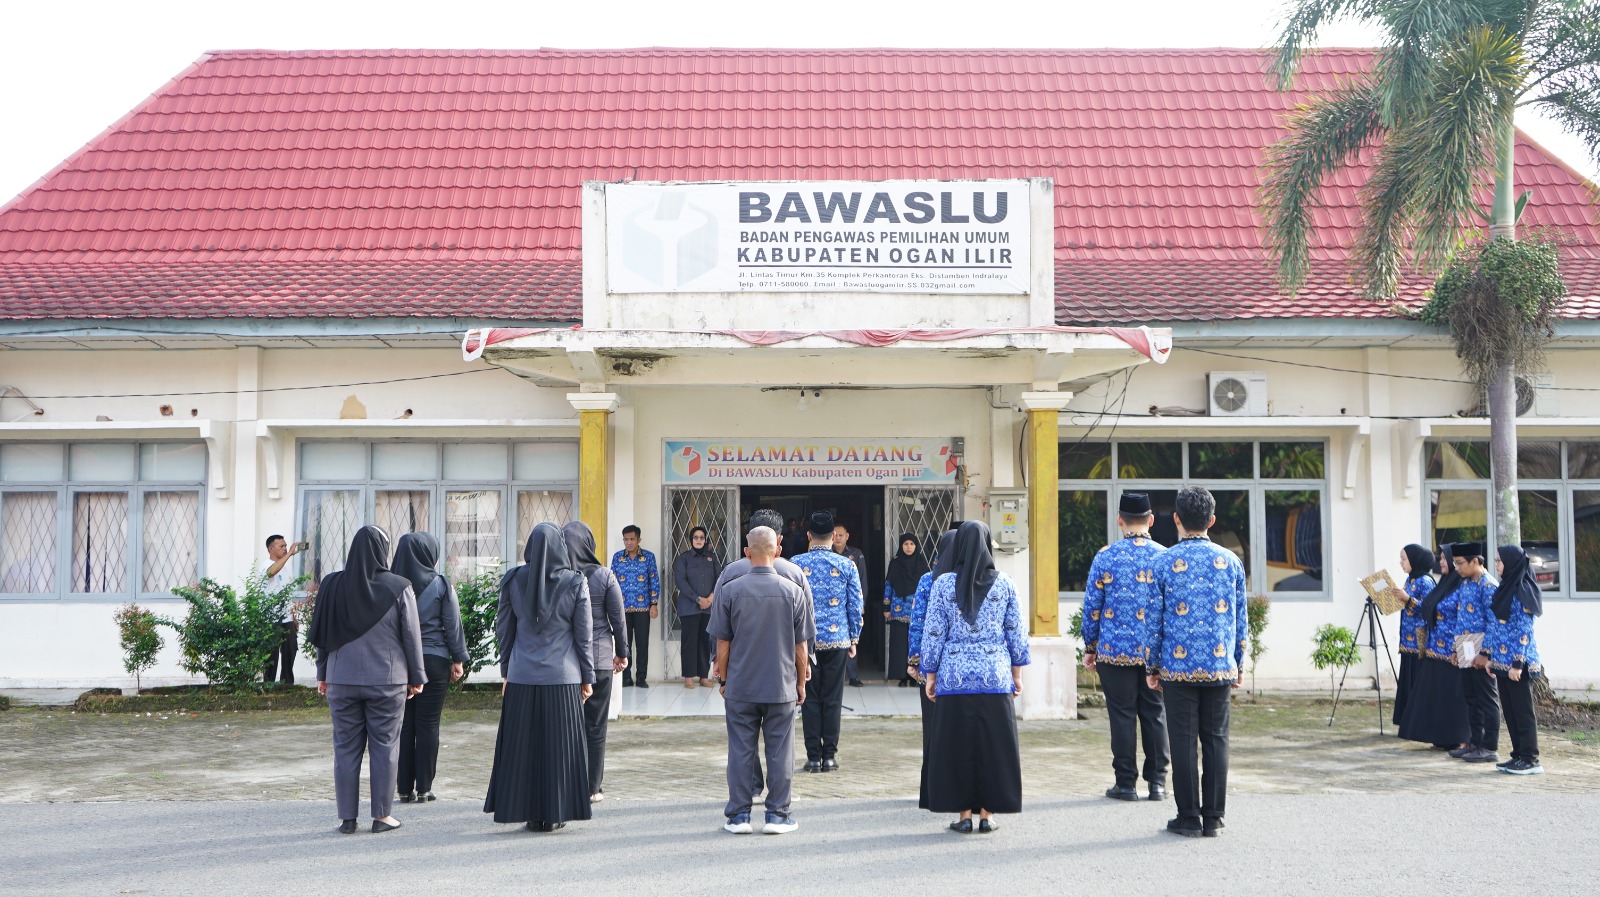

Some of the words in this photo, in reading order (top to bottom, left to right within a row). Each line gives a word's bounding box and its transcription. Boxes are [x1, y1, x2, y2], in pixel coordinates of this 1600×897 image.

[738, 191, 1009, 225] BAWASLU
[740, 230, 789, 243] BADAN
[794, 230, 876, 244] PENGAWAS
[880, 231, 960, 244] PEMILIHAN
[964, 231, 1010, 244] UMUM
[737, 247, 879, 263] KABUPATEN
[889, 248, 955, 264] OGAN
[965, 248, 1013, 264] ILIR
[827, 271, 861, 280] Komplek
[972, 272, 1008, 281] Indralaya
[707, 445, 819, 463] SELAMAT
[827, 445, 924, 463] DATANG
[708, 468, 722, 478] Di
[726, 467, 788, 478] BAWASLU
[792, 467, 863, 481] Kabupaten
[866, 467, 898, 480] Ogan
[902, 467, 923, 479] Ilir
